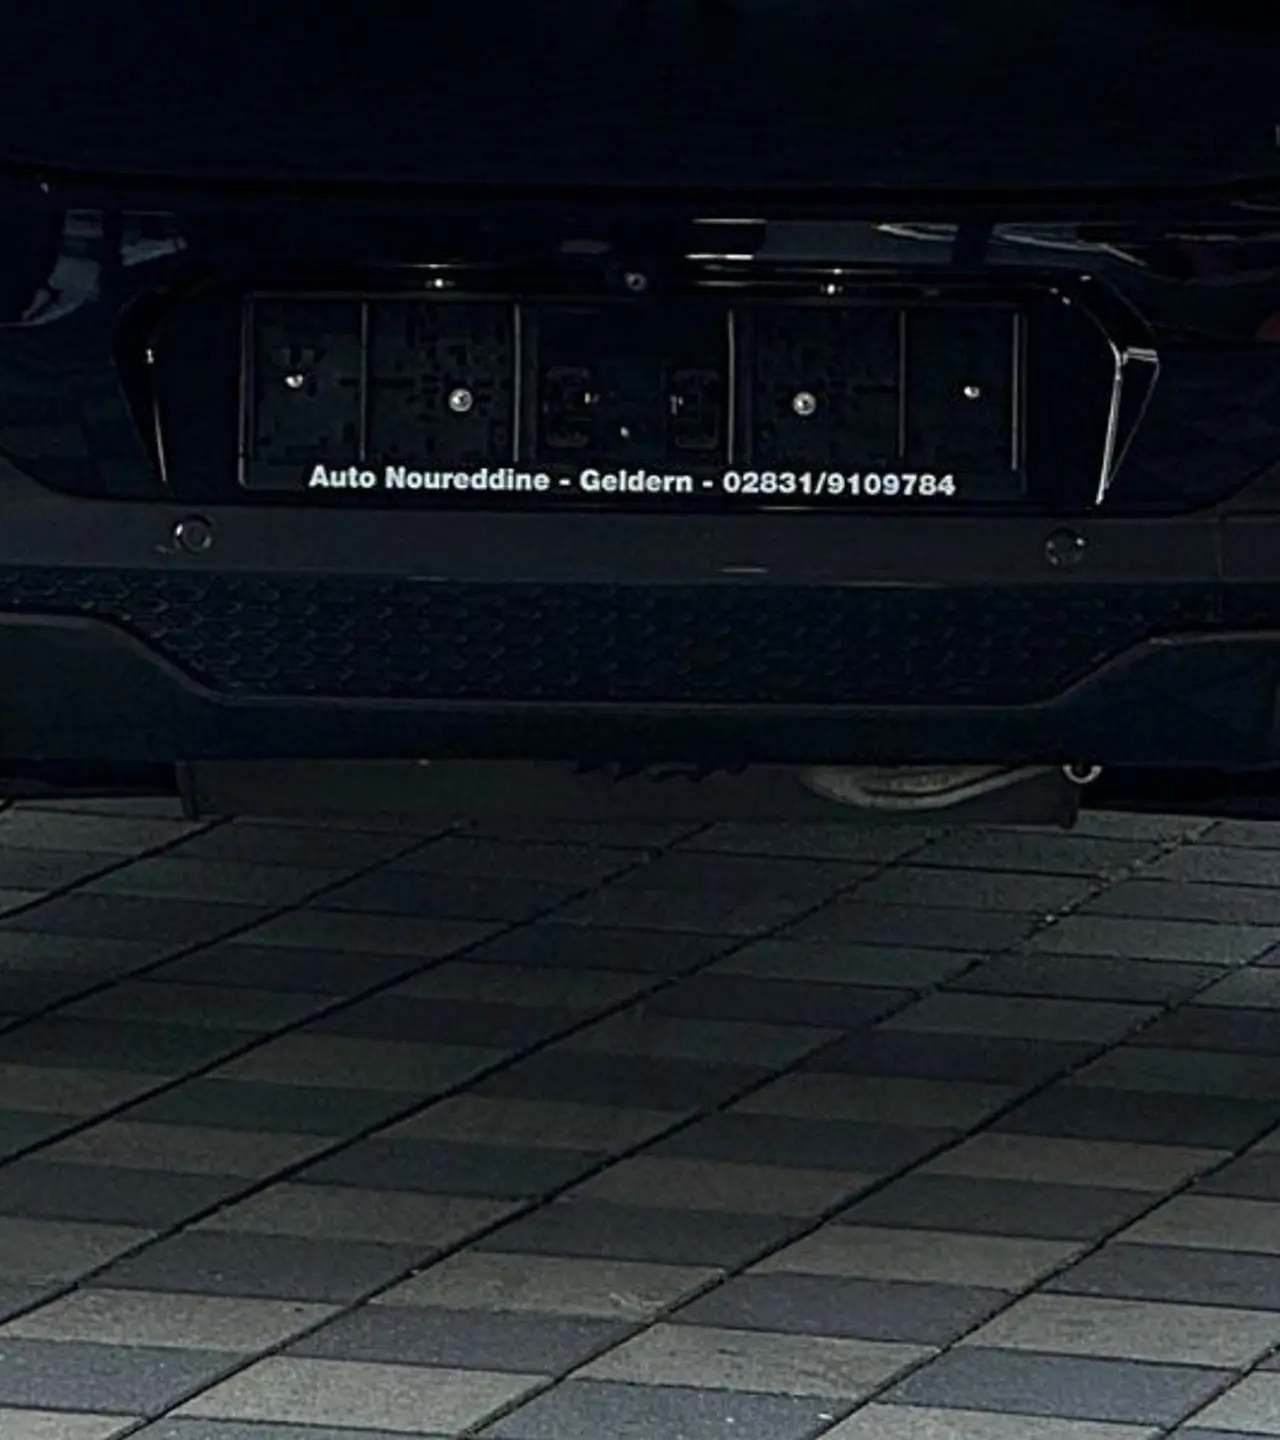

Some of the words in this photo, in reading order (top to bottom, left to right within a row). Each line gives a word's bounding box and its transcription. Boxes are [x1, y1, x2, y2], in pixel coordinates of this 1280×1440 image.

[309, 465, 377, 489] Auto
[384, 465, 550, 491] Noureddine
[579, 468, 694, 494] Geldern
[722, 470, 956, 496] 02831/9109784
